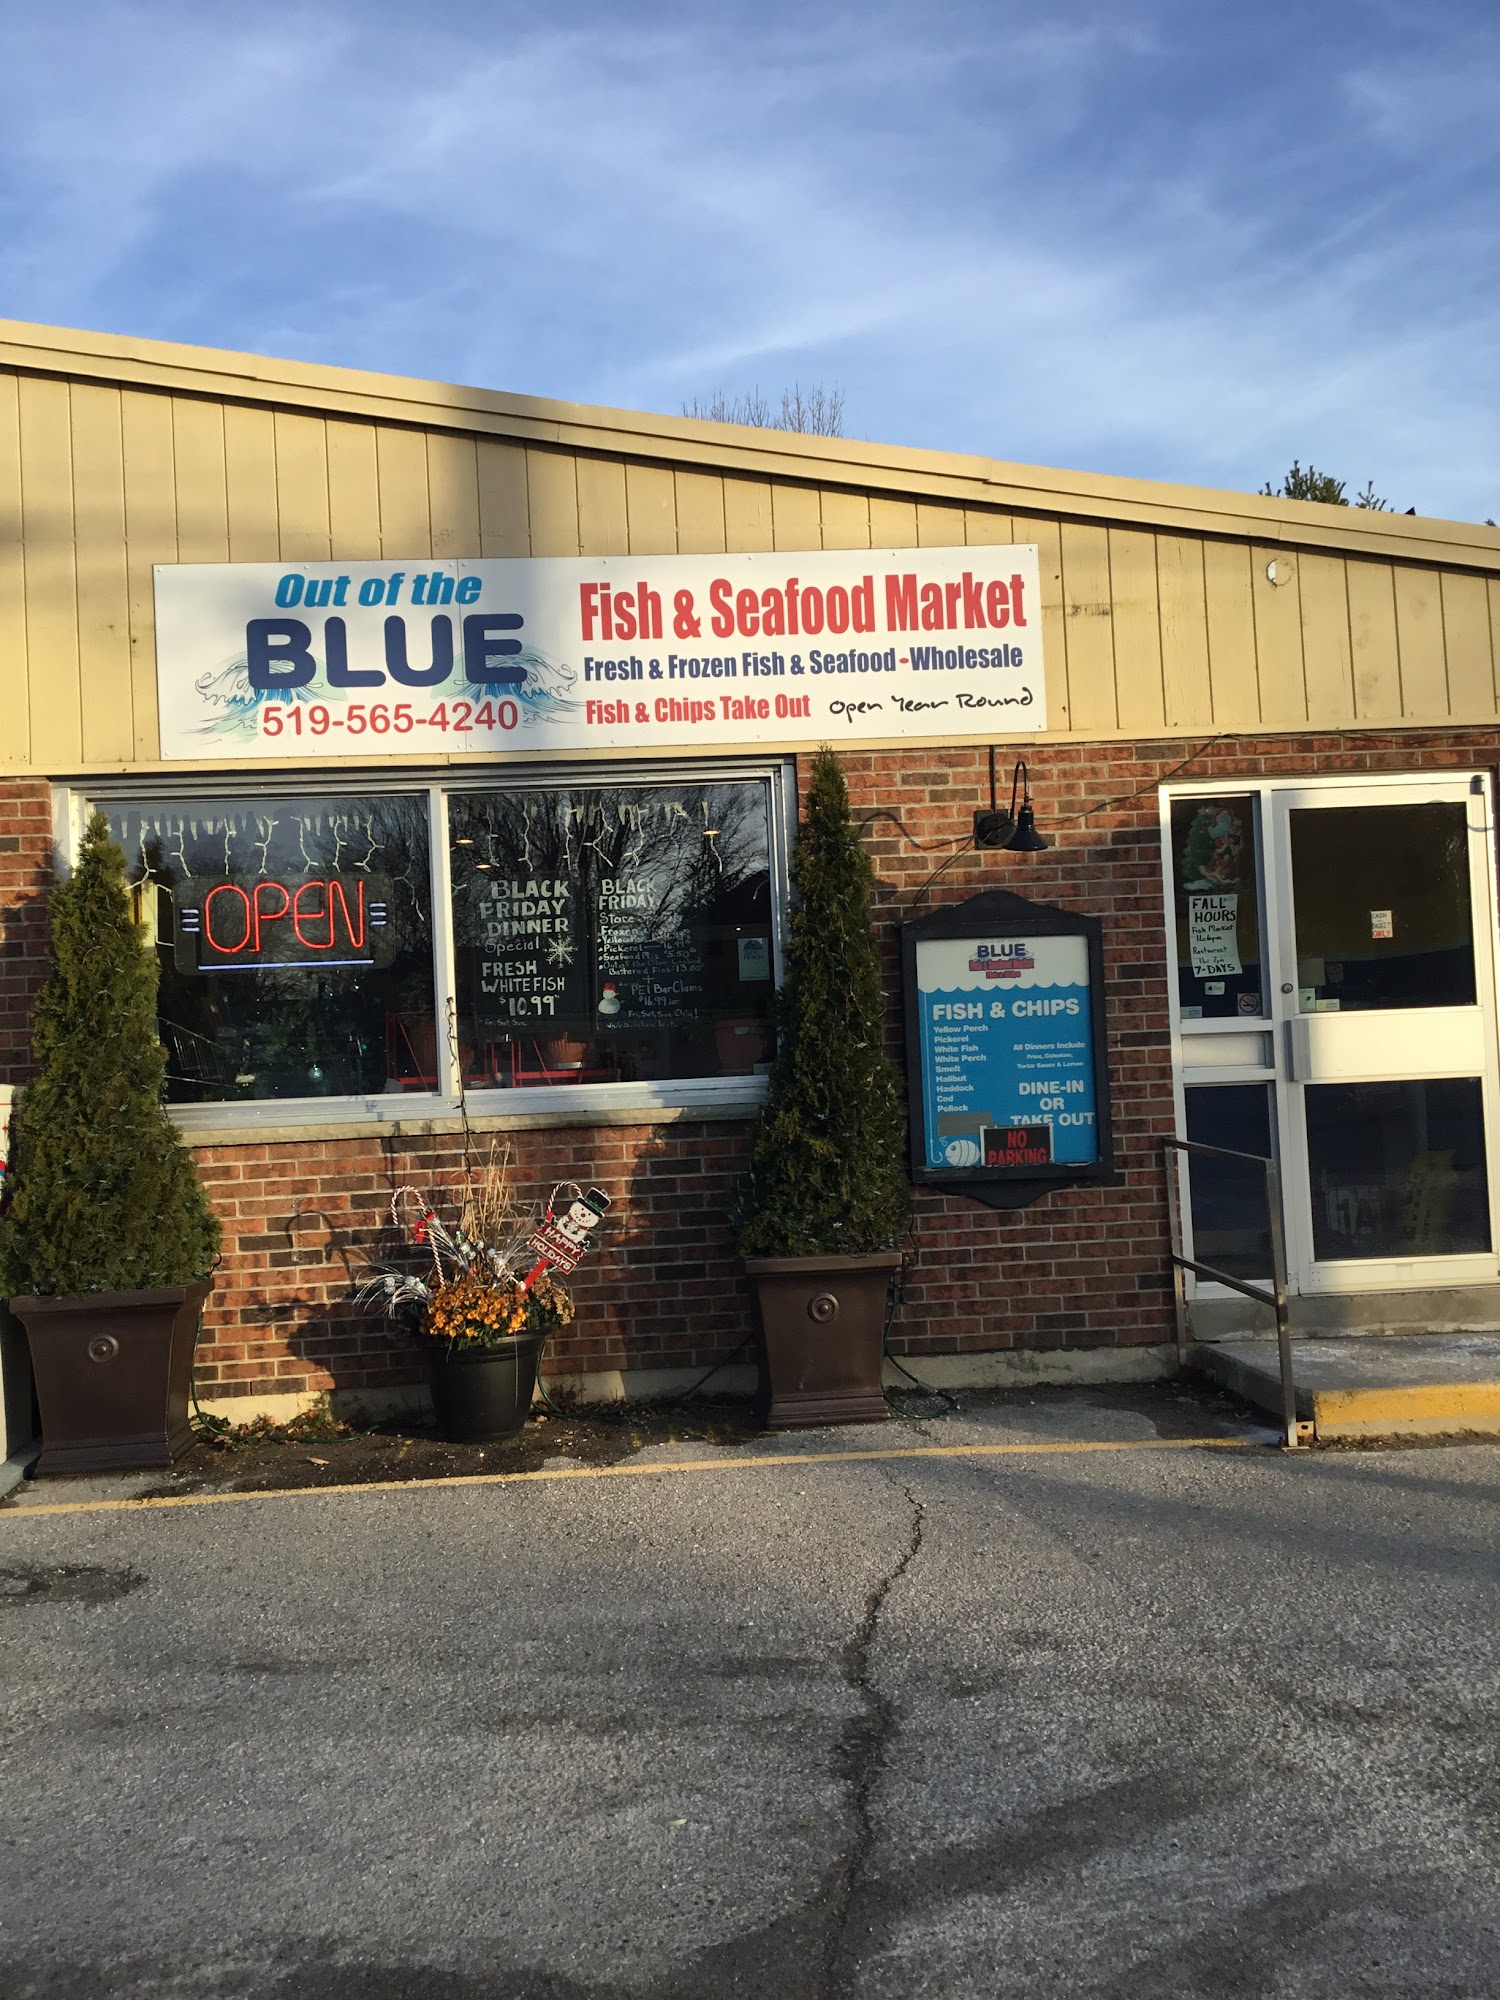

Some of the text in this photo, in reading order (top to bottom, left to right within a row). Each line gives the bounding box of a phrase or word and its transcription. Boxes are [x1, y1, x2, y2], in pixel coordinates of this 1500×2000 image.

[275, 571, 482, 608] Out of the
[579, 572, 1027, 641] Fish & Seafood Market
[246, 613, 529, 690] BLUE
[584, 655, 643, 681] Fresh
[648, 658, 664, 679] &
[668, 655, 737, 678] Frozen
[742, 651, 785, 676] Fish
[790, 654, 805, 675] &
[890, 695, 949, 713] Year
[956, 686, 1034, 709] Round
[586, 694, 811, 724] Fish & Chips Take Out
[261, 700, 519, 737] 519-565-4240
[491, 879, 570, 900] BLACK
[601, 879, 657, 895] BLACK
[479, 899, 566, 919] FRIDAY
[599, 893, 654, 910] FRIDAY
[1193, 897, 1226, 909] FALL
[204, 880, 365, 953] OPEN
[599, 912, 634, 924] Store
[1194, 909, 1236, 923] HOURS
[1372, 912, 1387, 920] CASH
[487, 917, 569, 937] DINNER
[1192, 926, 1206, 934] Fish
[1371, 921, 1391, 930] DEBIT
[1371, 929, 1391, 938] ONLY
[485, 936, 540, 957] Special
[604, 944, 642, 953] Pickerel
[977, 943, 1026, 958] BLUE
[603, 952, 641, 961] Seafood
[481, 960, 538, 977] FRESH
[932, 998, 1080, 1021] FISH & CHIPS
[963, 1024, 989, 1032] Perch
[934, 1035, 969, 1043] Pickerel
[1013, 1041, 1086, 1051] All Dinners Include
[961, 1044, 979, 1052] Fish
[935, 1053, 987, 1063] White Perch
[935, 1065, 961, 1073] Smelt
[936, 1074, 967, 1083] Halibut
[936, 1084, 974, 1093] Haddock
[1018, 1079, 1085, 1096] DINE-IN
[937, 1095, 954, 1103] Cod
[1039, 1097, 1065, 1111] OR
[937, 1104, 969, 1113] Pollock
[1010, 1112, 1095, 1126] TAKE OUT
[1007, 1130, 1028, 1148] NO
[988, 1147, 1047, 1165] PARKING
[544, 1226, 581, 1255] HAPPY
[530, 1238, 573, 1270] HOLIDAYS
